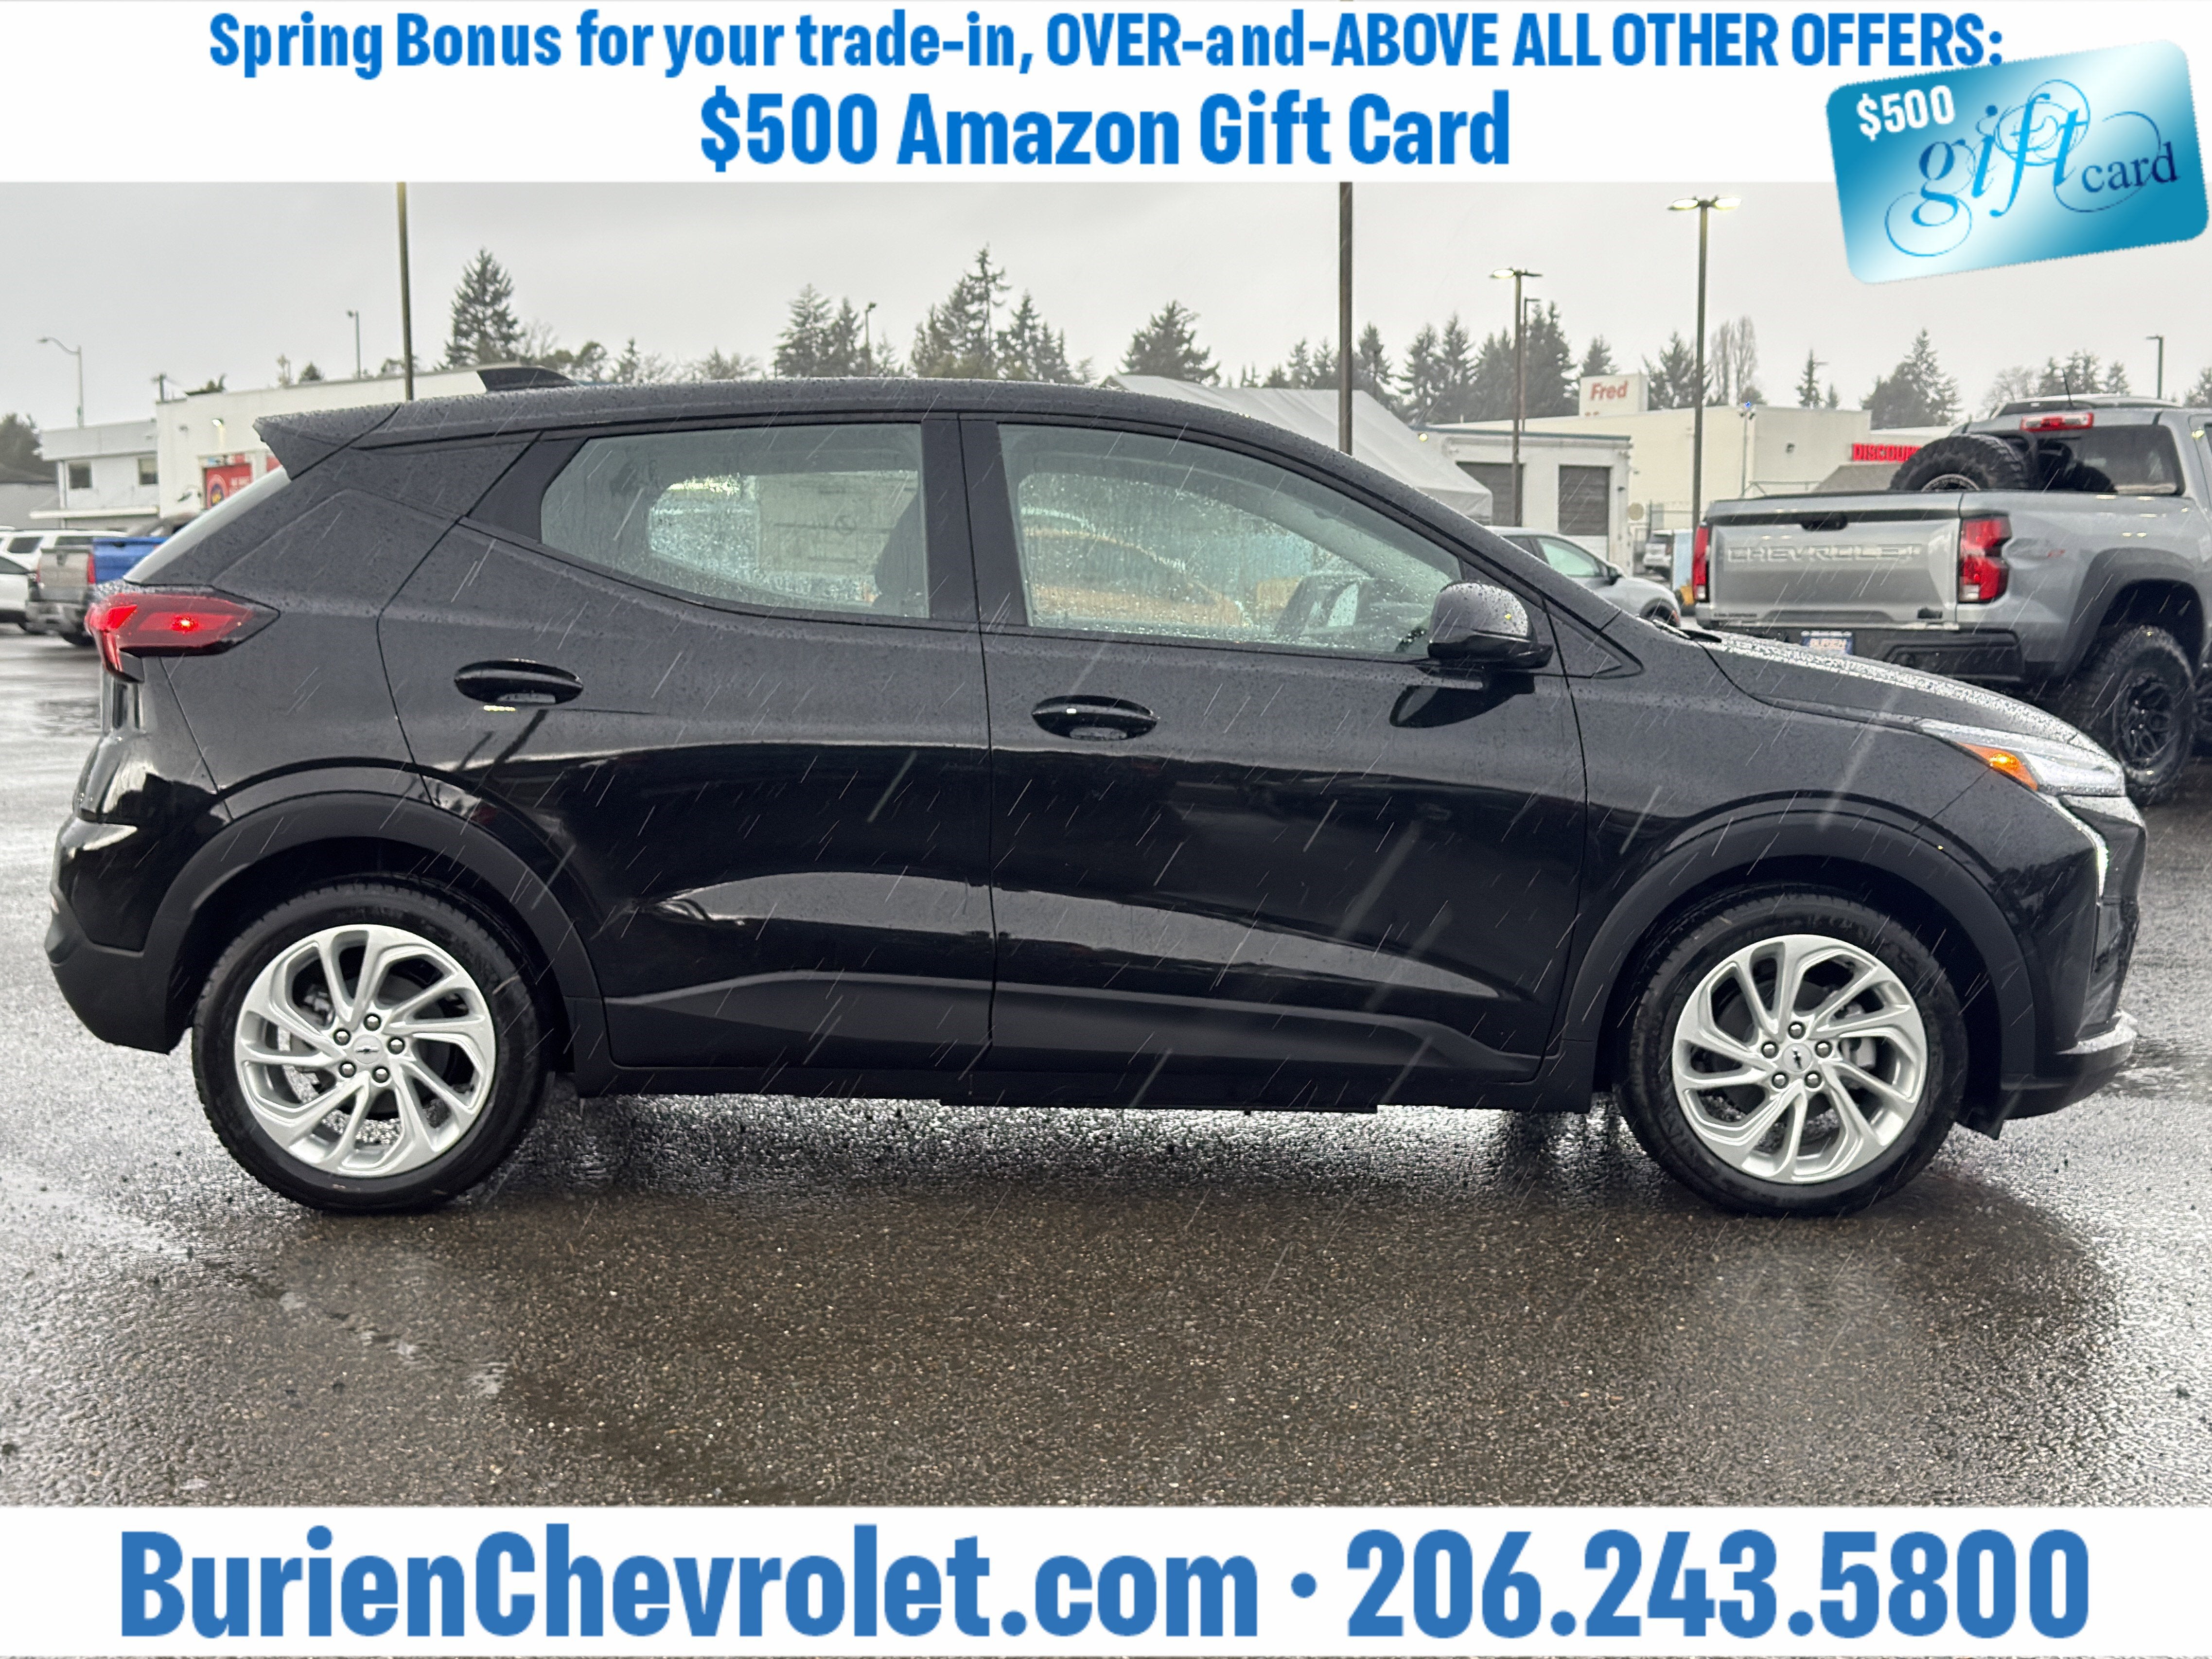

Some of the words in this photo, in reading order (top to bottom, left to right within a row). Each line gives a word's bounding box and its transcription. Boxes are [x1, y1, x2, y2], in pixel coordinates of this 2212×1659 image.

[1590, 380, 1628, 400] Fred
[1853, 443, 1921, 462] DISCOUN
[1728, 544, 1922, 563] CHEVROLET
